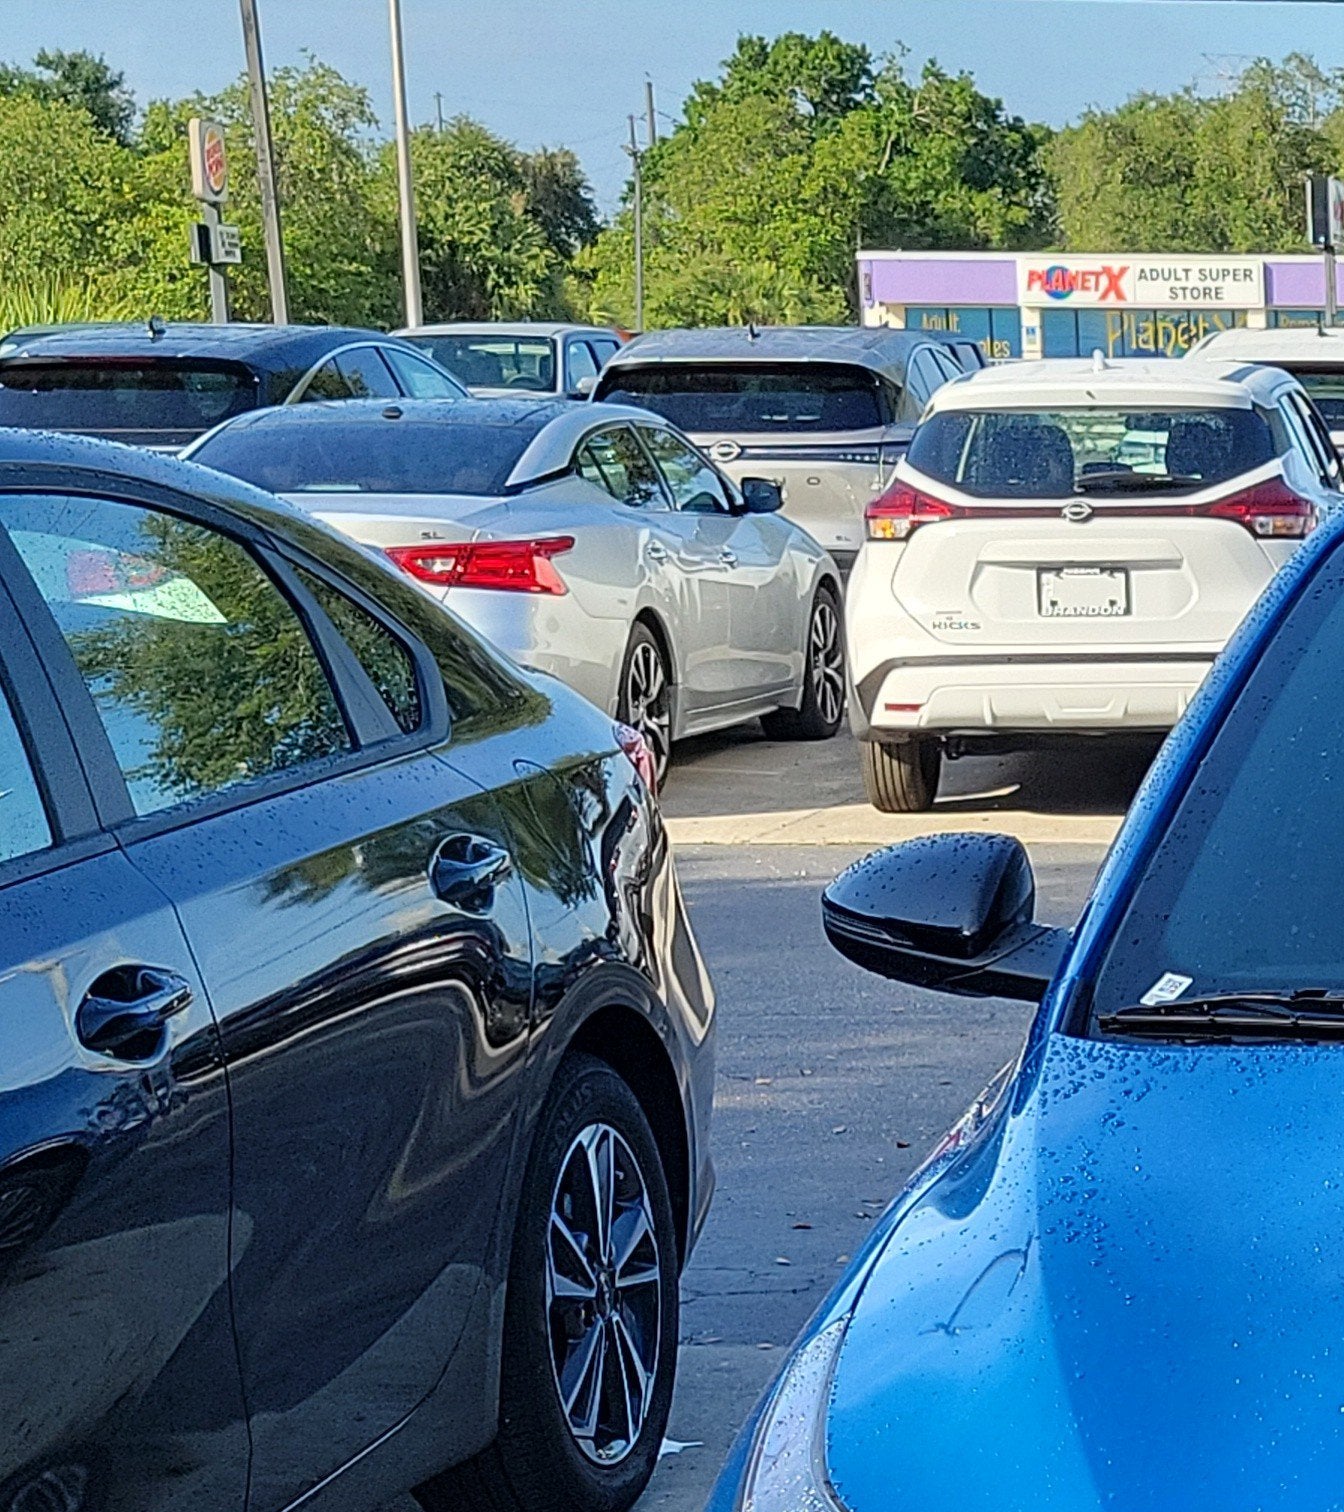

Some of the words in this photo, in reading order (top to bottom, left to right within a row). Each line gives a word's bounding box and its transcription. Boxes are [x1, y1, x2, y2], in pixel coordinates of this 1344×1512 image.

[1137, 268, 1192, 282] ADULT
[1198, 268, 1254, 282] SUPER
[1168, 286, 1225, 300] STORE
[1041, 605, 1126, 617] BRANDON
[932, 620, 982, 631] KICKS
